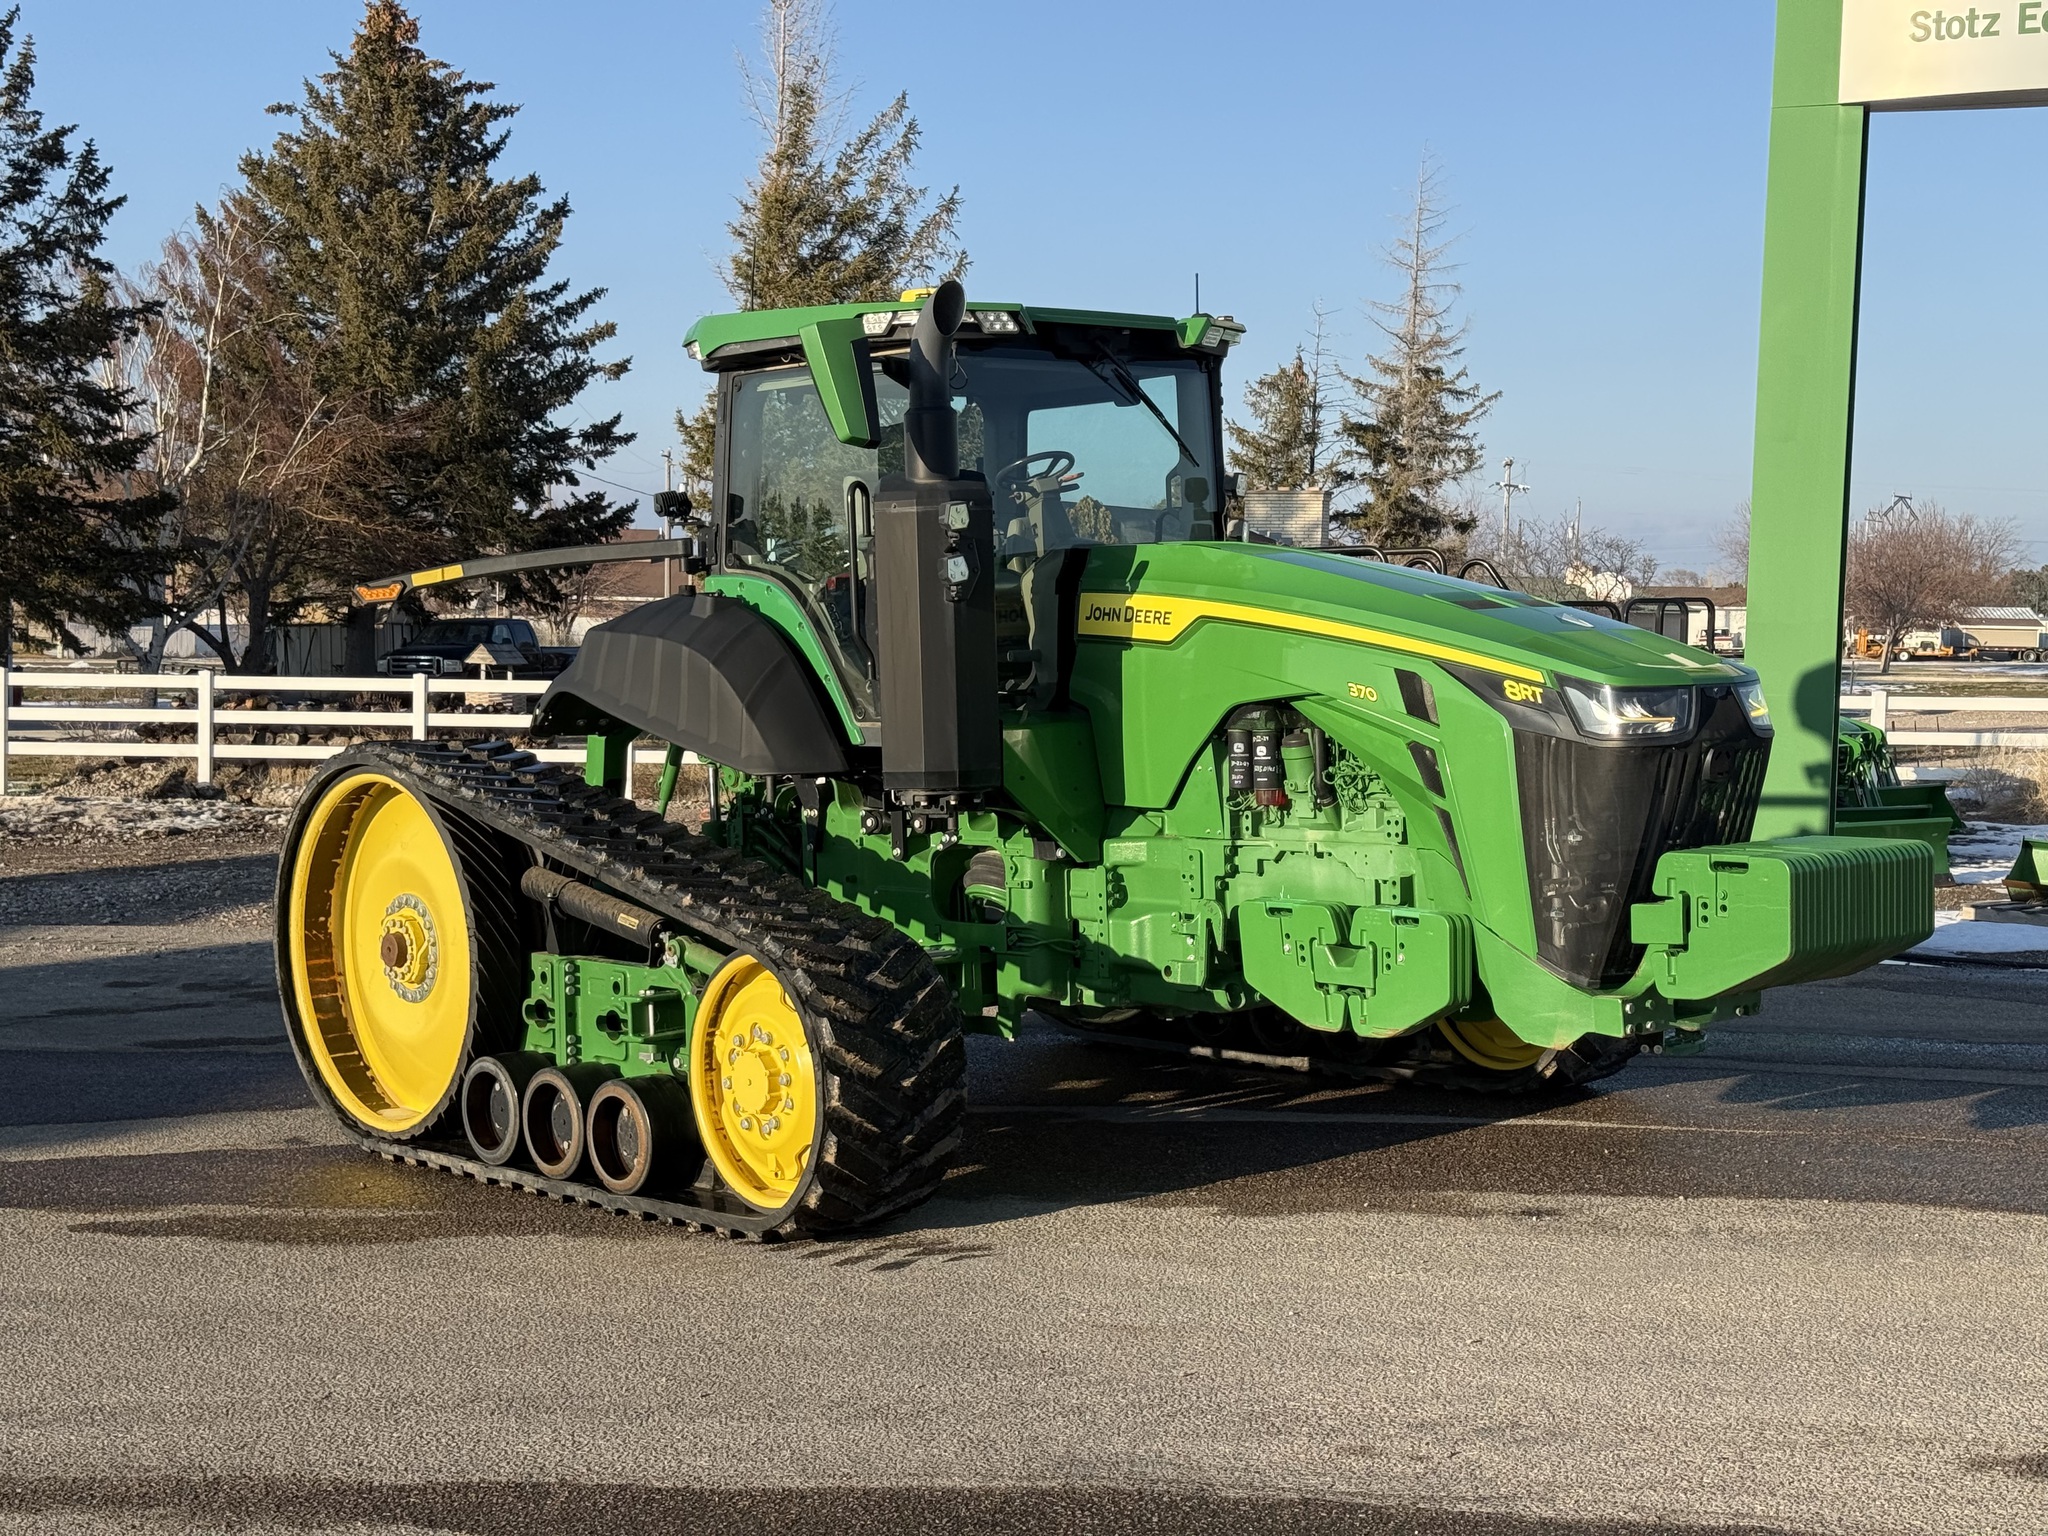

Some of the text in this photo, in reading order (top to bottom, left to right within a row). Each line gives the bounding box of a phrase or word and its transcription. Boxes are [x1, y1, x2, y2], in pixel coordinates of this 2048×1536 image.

[1908, 1, 2048, 42] Stotz E
[1085, 603, 1172, 625] JOHN DEERE
[1347, 681, 1378, 702] 370
[1503, 679, 1544, 704] 8RT
